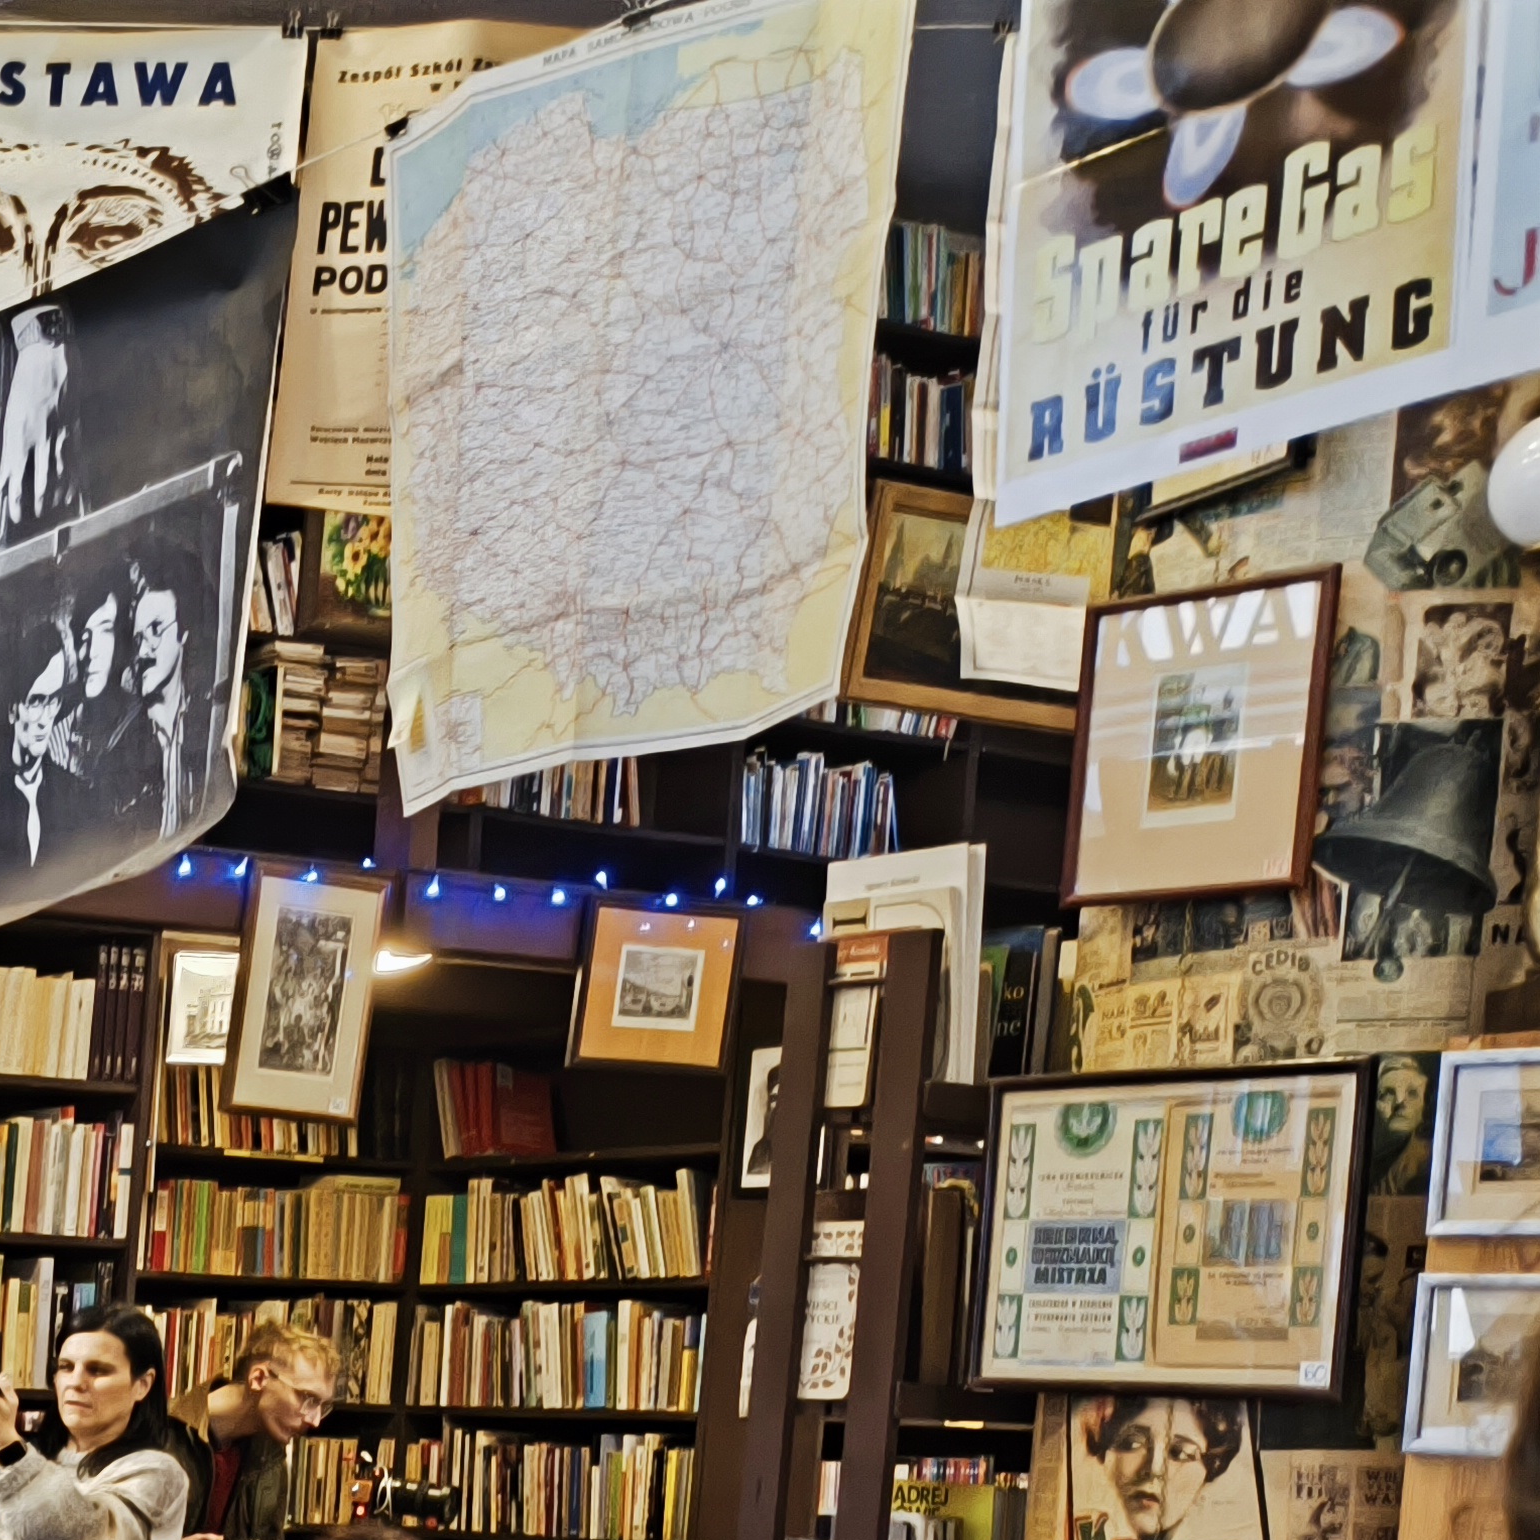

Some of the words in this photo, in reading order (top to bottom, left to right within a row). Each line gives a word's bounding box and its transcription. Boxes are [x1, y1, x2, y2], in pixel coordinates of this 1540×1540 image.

[337, 65, 402, 84] Zespół
[409, 57, 463, 78] Szkół
[1142, 299, 1209, 354] für
[1231, 268, 1304, 322] die
[1028, 276, 1434, 463] RÜSTUNG
[1033, 1267, 1108, 1285] MISTRZA
